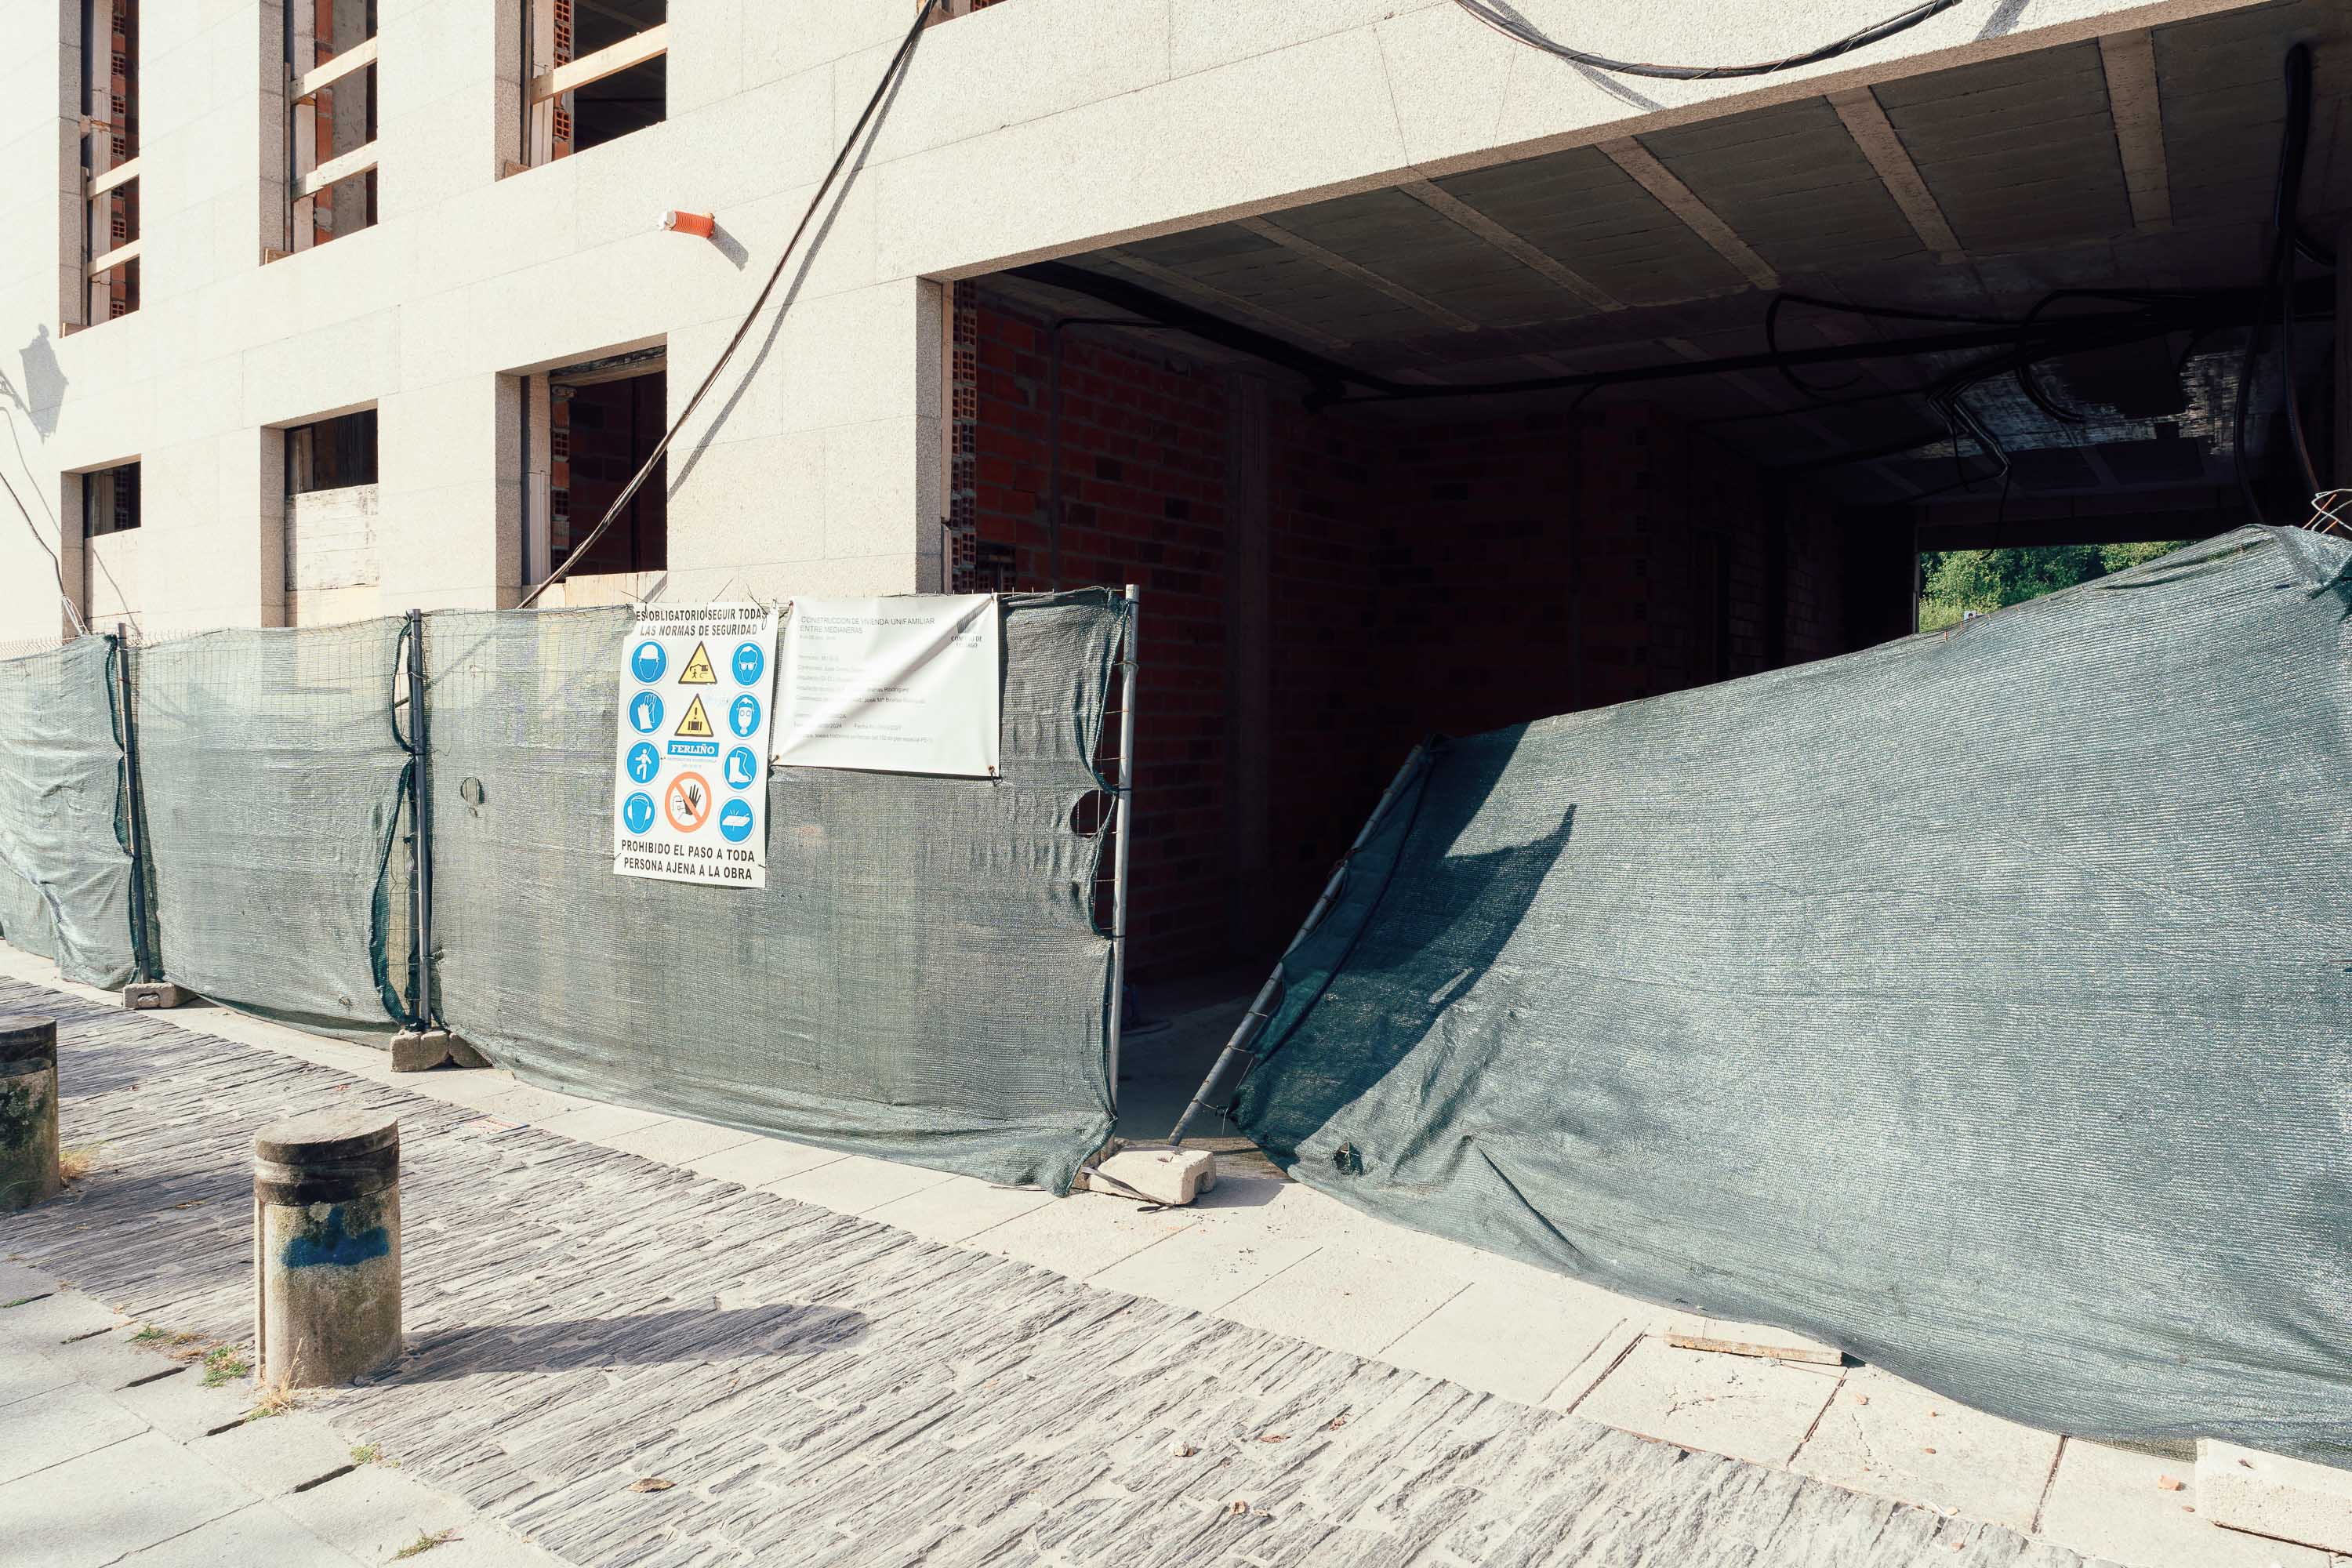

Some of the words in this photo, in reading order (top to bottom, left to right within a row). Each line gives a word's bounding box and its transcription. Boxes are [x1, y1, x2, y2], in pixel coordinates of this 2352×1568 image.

[649, 610, 705, 621] OBLIGATORIO
[708, 609, 735, 619] SEGUIR
[891, 617, 935, 626] UNIFAMILIAR
[640, 625, 656, 636] LAS
[659, 625, 695, 636] NORMAS
[699, 625, 710, 636] DE
[712, 623, 757, 636] SEGURIDAD
[671, 743, 715, 754] FERLIÑO
[622, 840, 670, 855] PROHIBIDO
[673, 844, 684, 856] EL
[688, 846, 713, 858] PASO
[717, 848, 722, 860] A
[726, 849, 755, 862] TODA
[624, 857, 663, 873] PERSONA
[666, 862, 695, 876] AJENA
[699, 865, 705, 877] A
[708, 866, 720, 877] LA
[724, 866, 752, 880] OBRA
